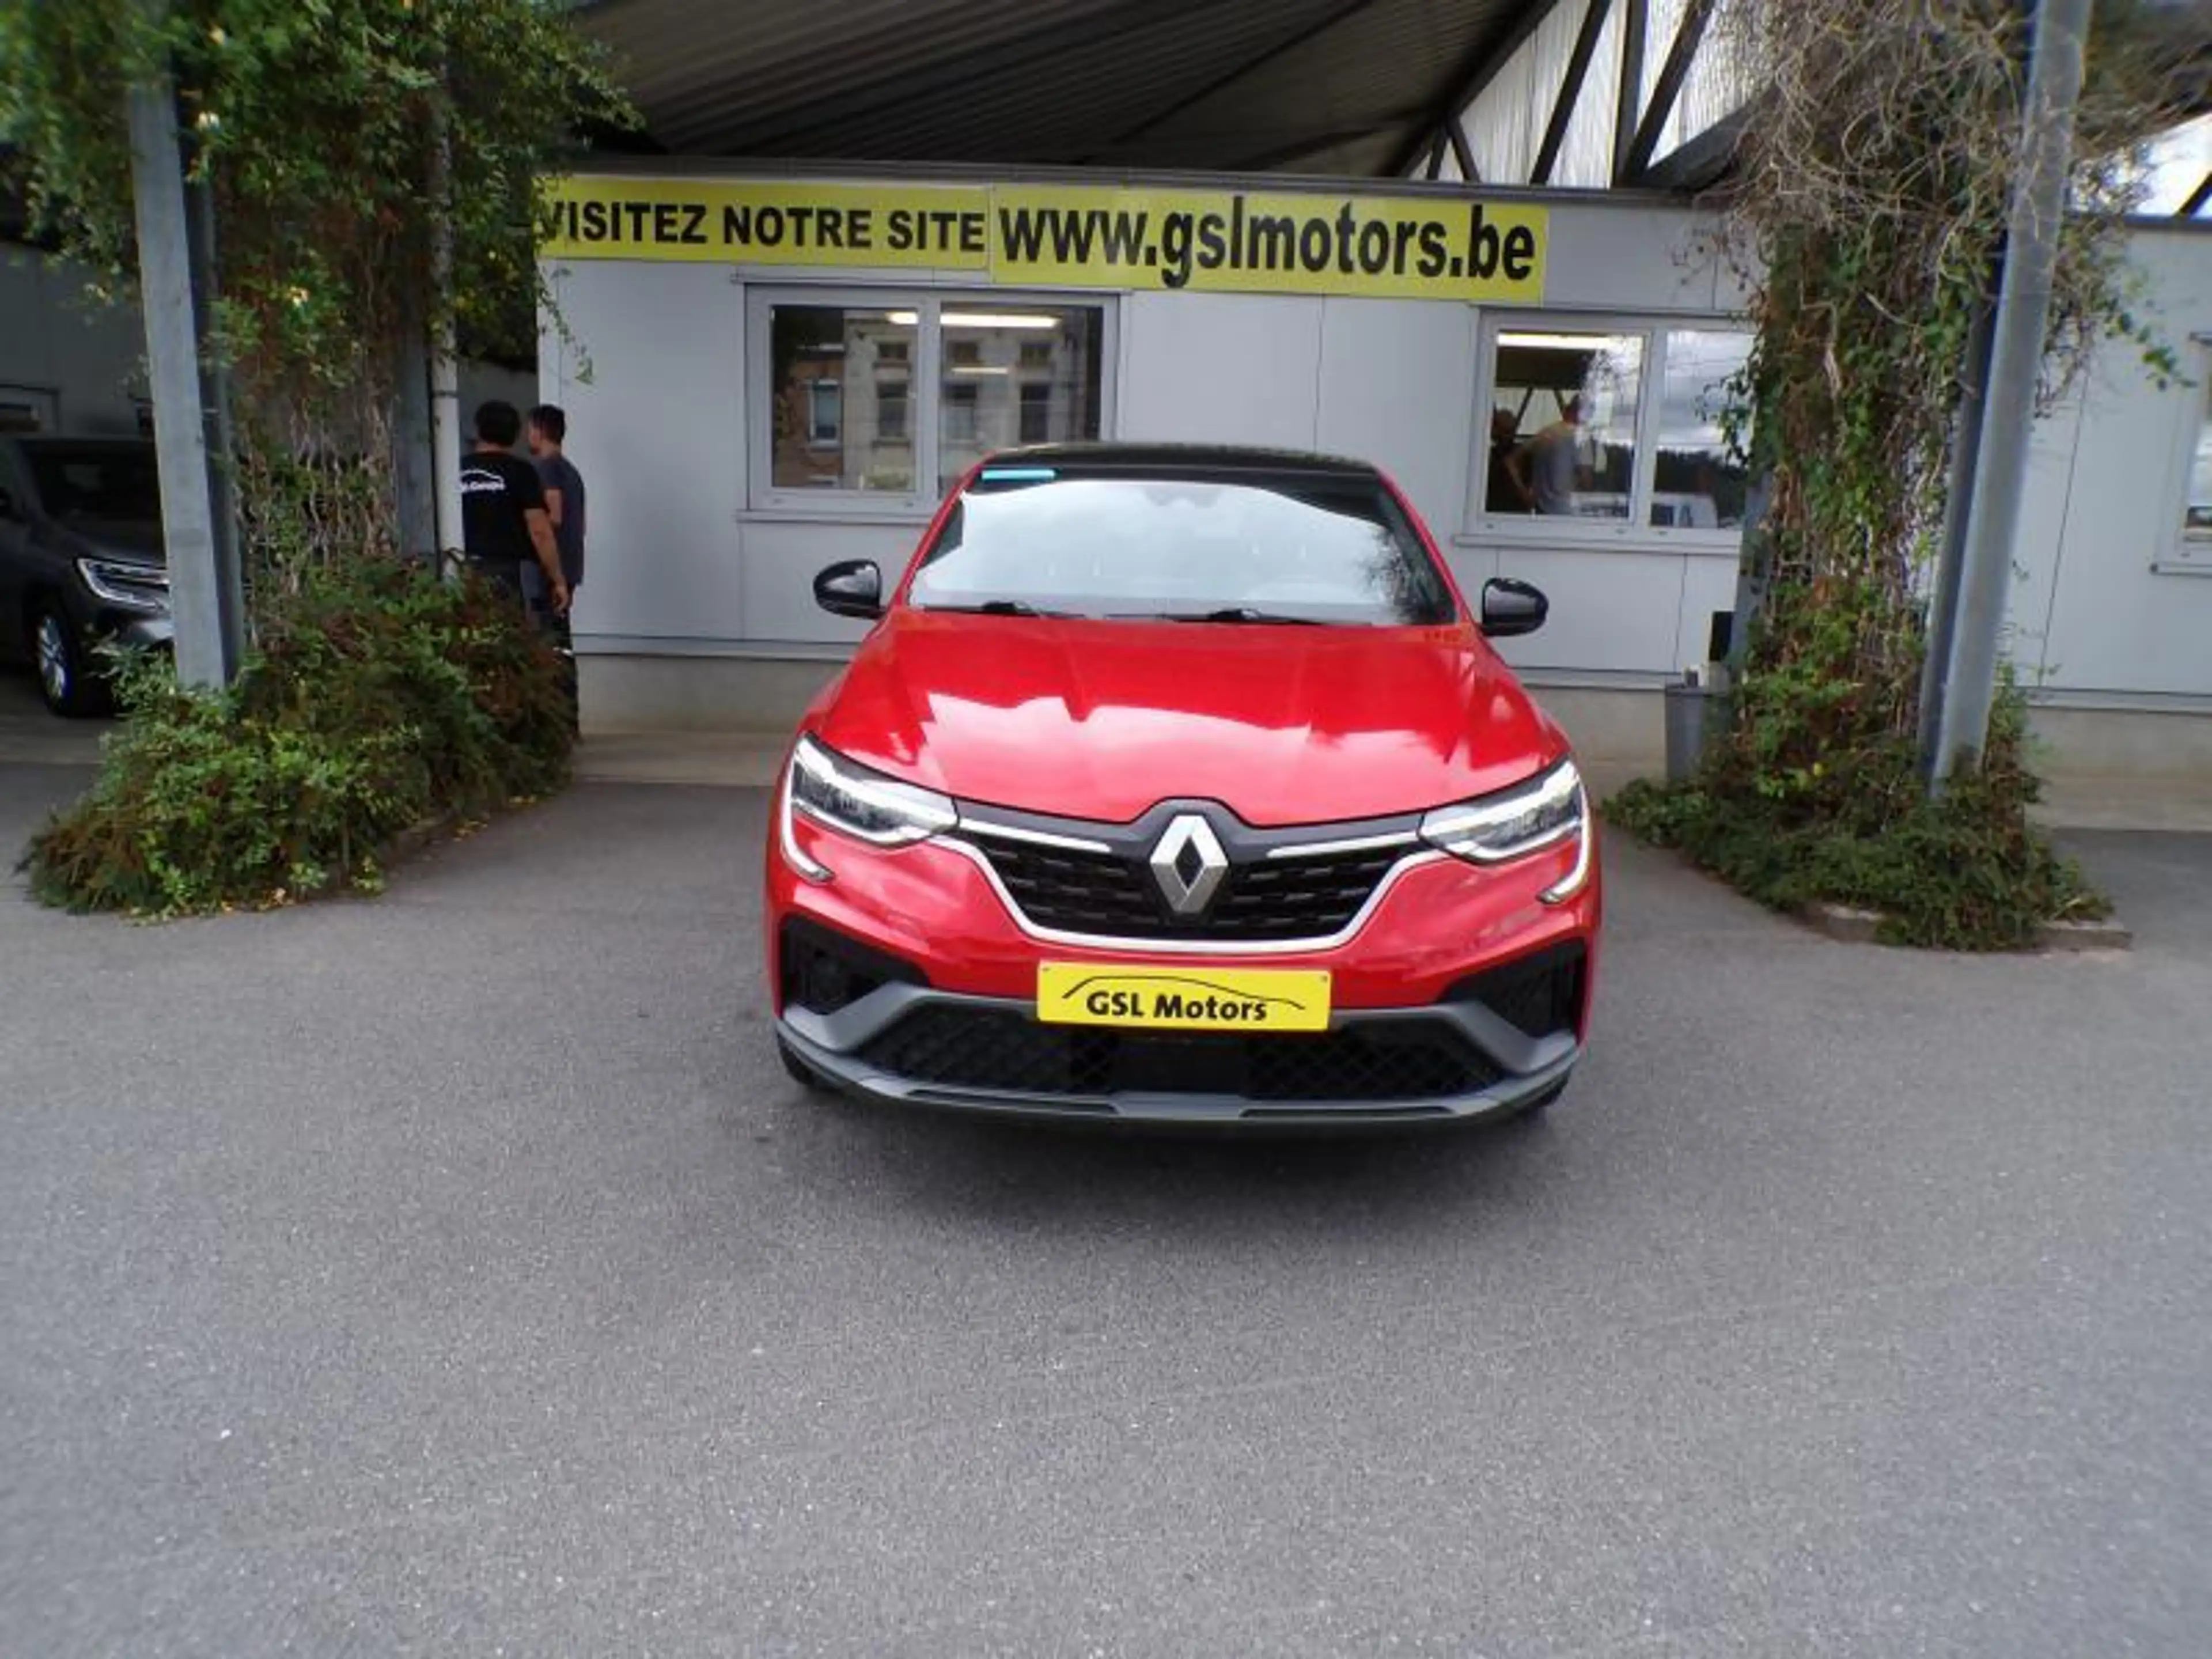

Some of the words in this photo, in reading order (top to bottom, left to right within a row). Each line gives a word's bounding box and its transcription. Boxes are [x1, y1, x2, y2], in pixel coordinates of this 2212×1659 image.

[543, 201, 707, 244] VISITEZ
[724, 206, 871, 248] NOTRE
[888, 210, 985, 251] SITE
[998, 196, 1535, 287] www.gslmotors.be
[1086, 991, 1144, 1017] GSL
[1153, 994, 1267, 1021] Motors
